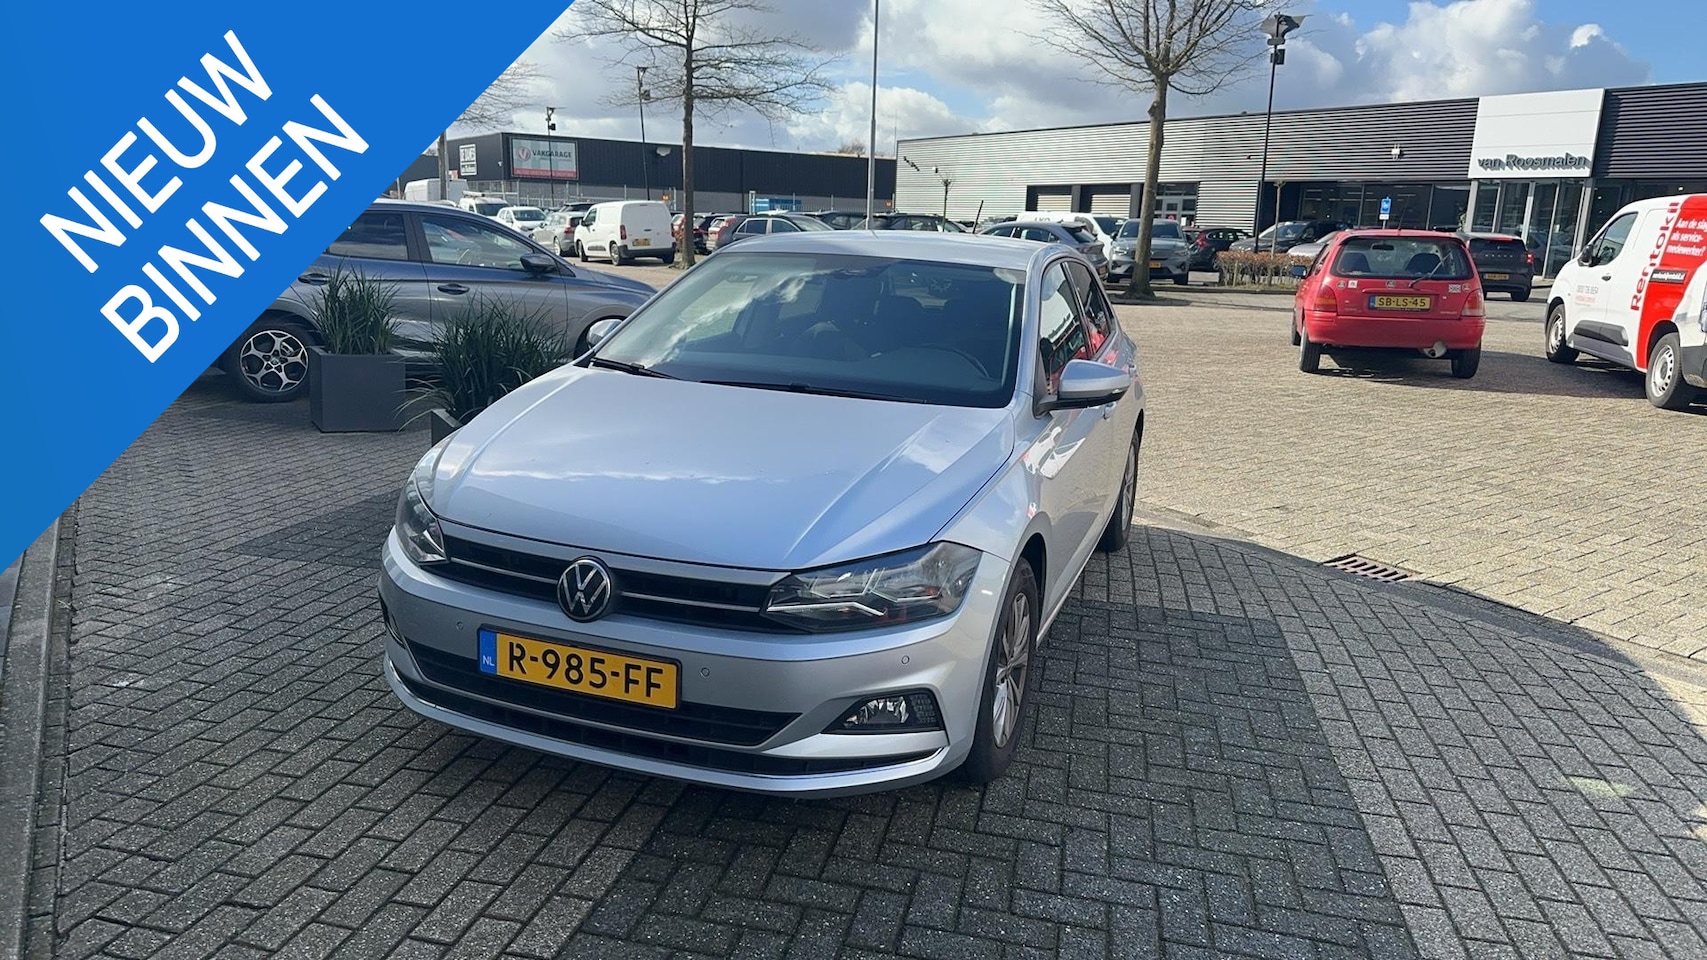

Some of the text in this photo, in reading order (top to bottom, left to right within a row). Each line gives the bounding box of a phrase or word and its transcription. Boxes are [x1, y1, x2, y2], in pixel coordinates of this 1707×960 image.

[532, 149, 572, 158] VAKGARAGE
[1478, 152, 1592, 171] van Roosmalen
[1378, 297, 1426, 307] SB-LS-45
[482, 641, 664, 698] NL R-985-FF
